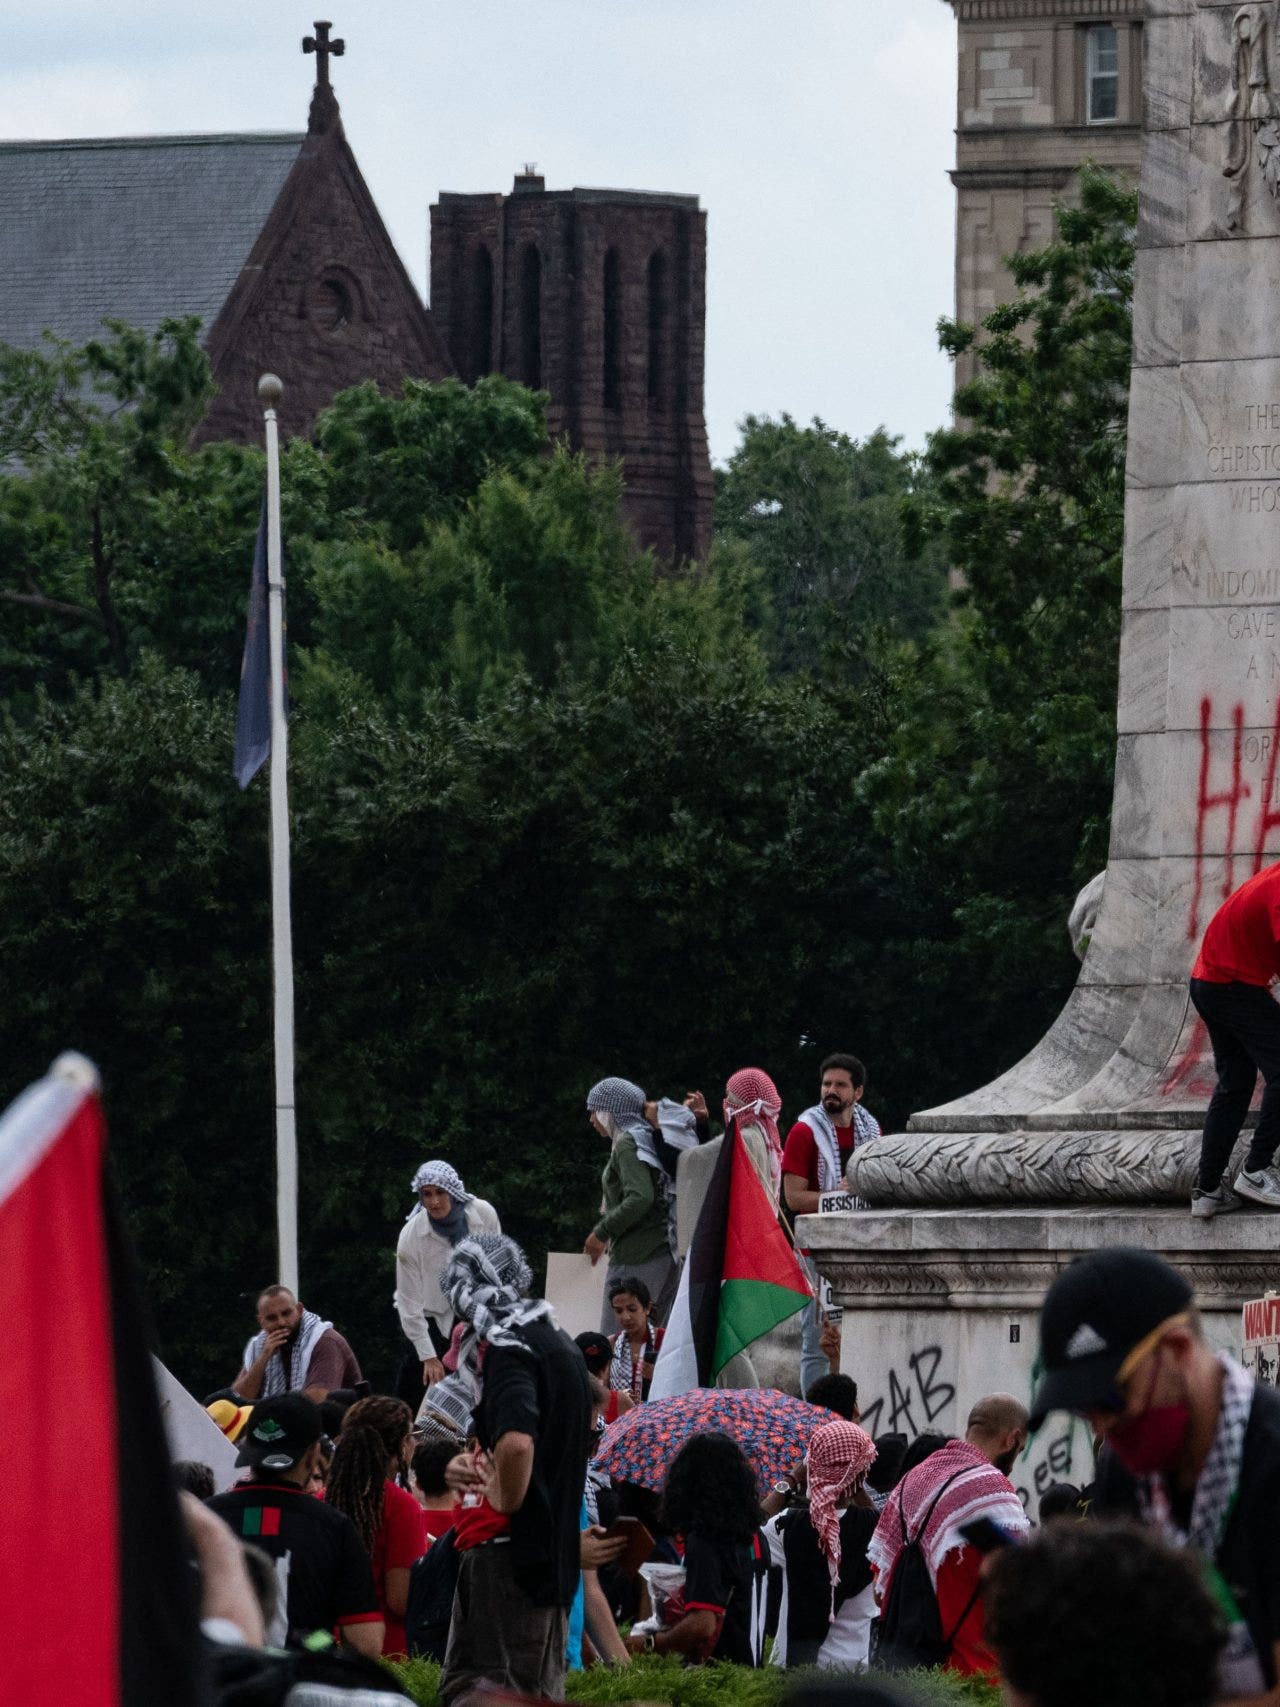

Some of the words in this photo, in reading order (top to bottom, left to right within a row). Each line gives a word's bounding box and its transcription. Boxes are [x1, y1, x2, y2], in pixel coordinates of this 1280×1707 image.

[1245, 403, 1280, 431] THE
[1227, 612, 1276, 640] GAVE
[1246, 654, 1259, 679] A
